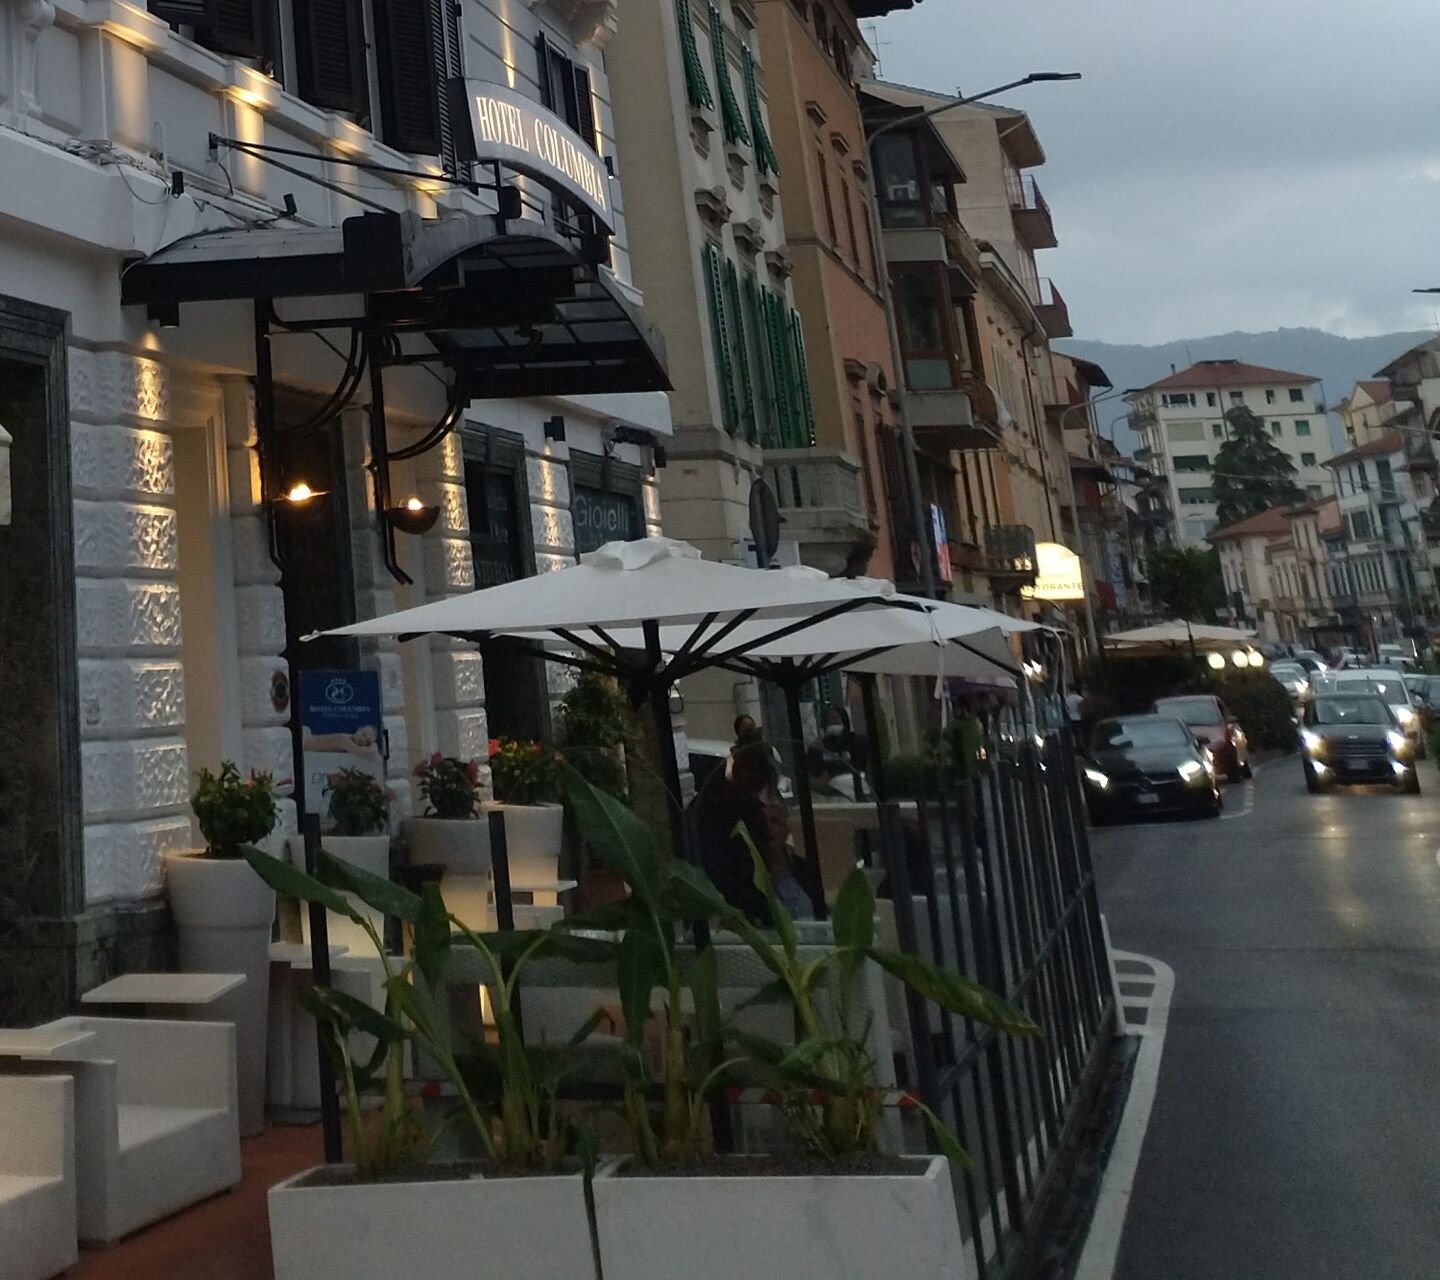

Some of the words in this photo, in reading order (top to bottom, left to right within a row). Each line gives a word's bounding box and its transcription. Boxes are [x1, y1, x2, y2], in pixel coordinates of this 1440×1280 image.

[475, 96, 530, 153] HOTEL
[534, 117, 608, 213] COLUMBIA
[574, 493, 629, 534] Gioielli
